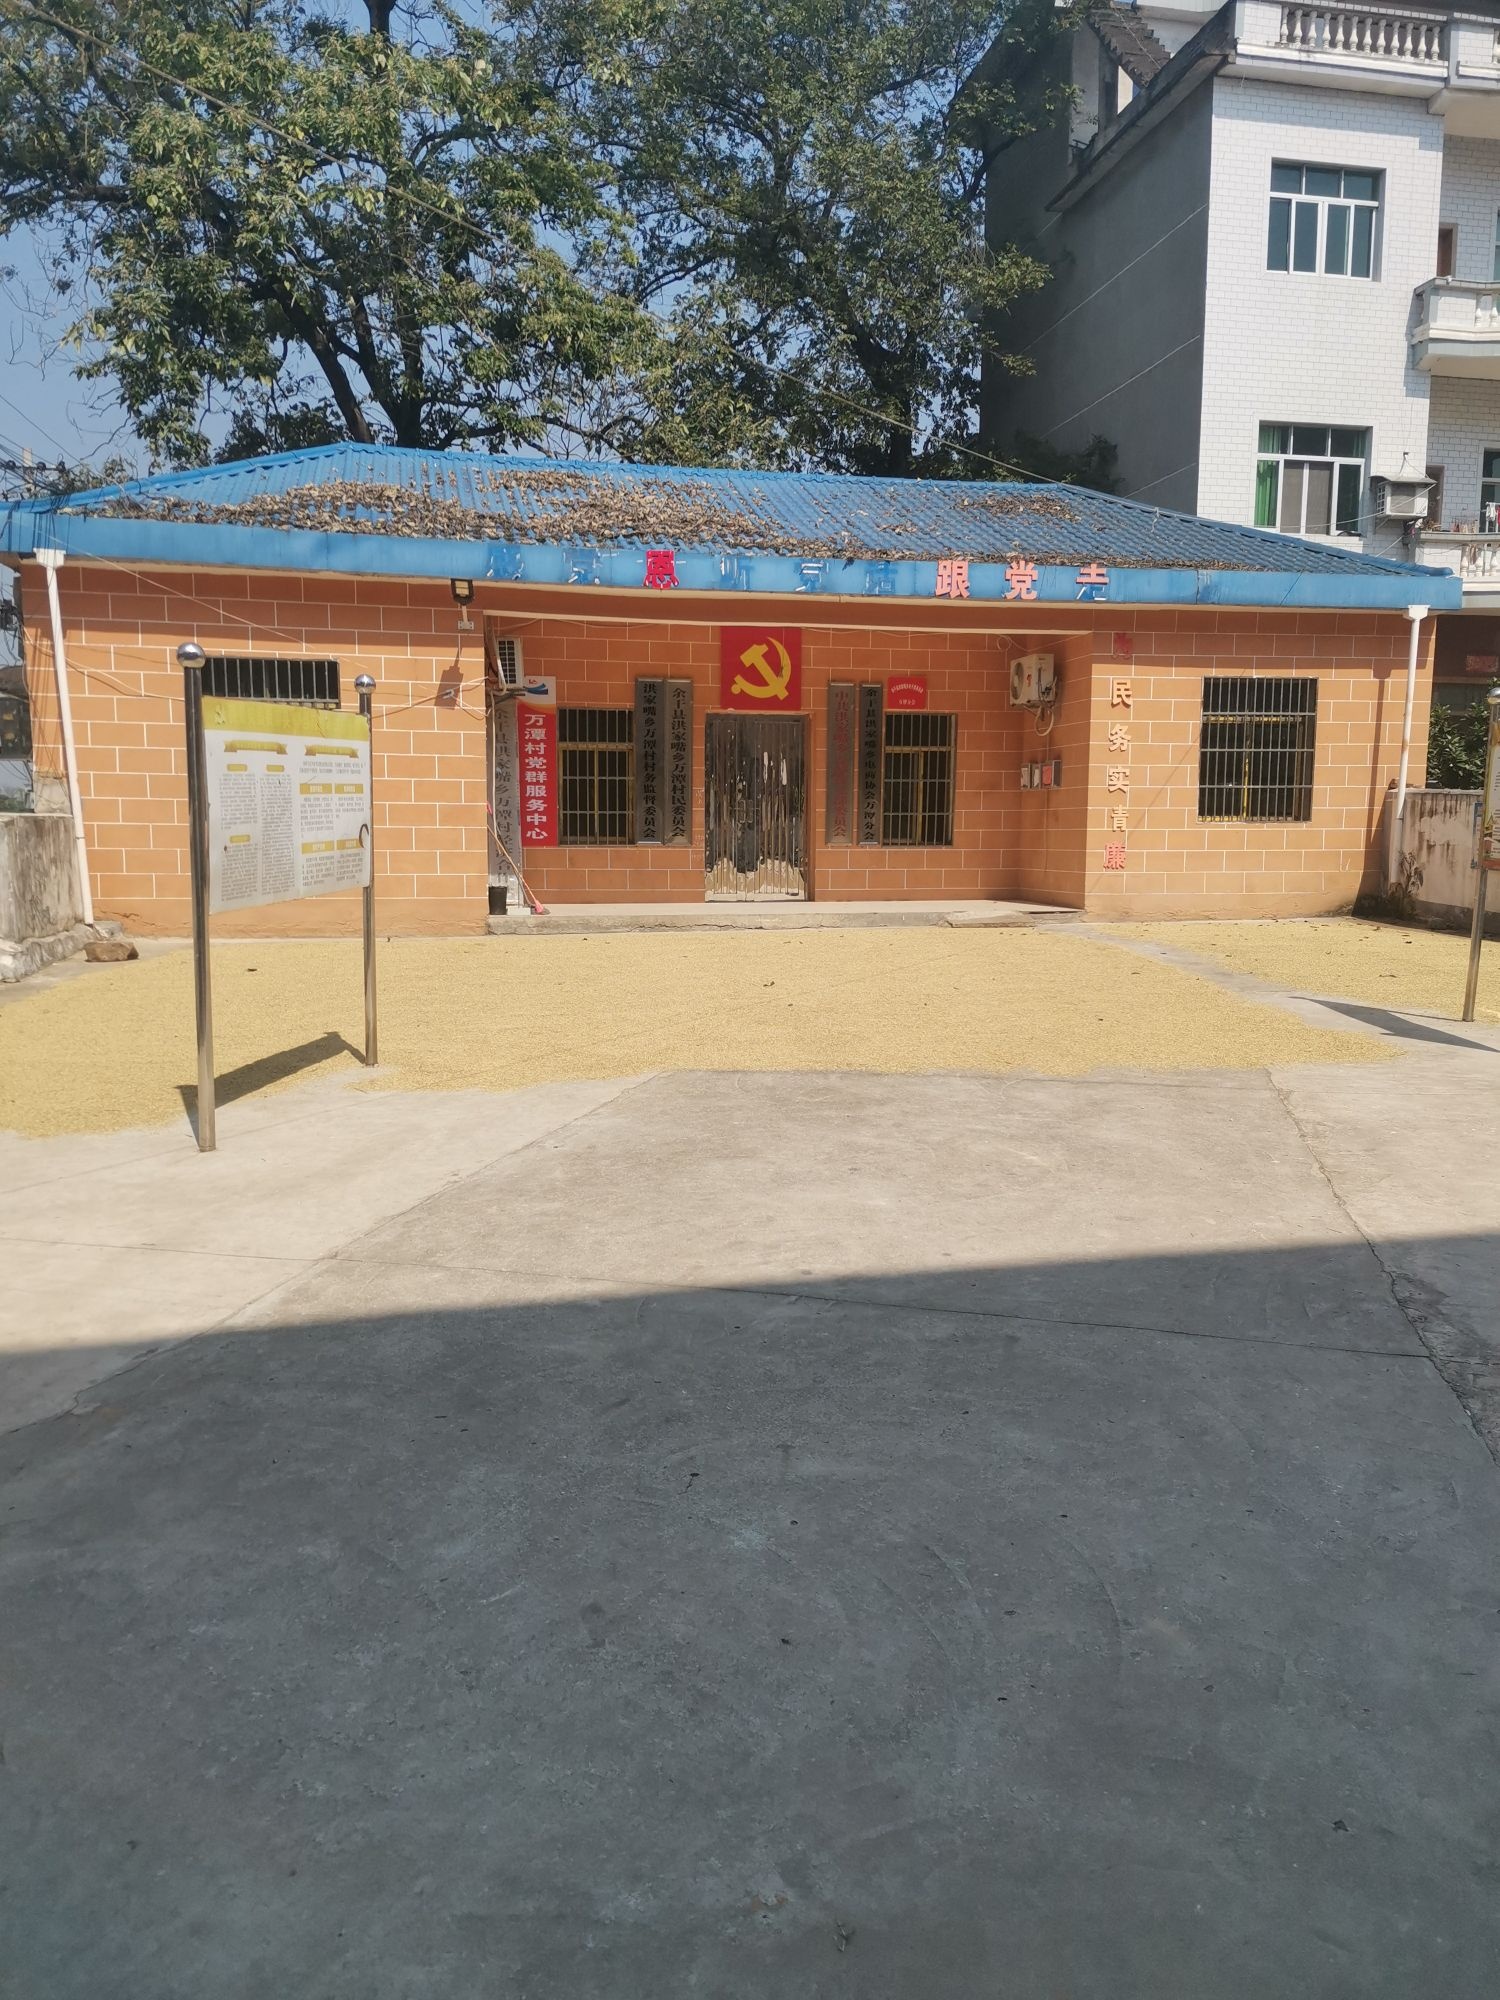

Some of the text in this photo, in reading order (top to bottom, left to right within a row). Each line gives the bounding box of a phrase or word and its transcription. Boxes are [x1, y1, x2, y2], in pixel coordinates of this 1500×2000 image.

[524, 713, 548, 839] 万潭村党群服务中心
